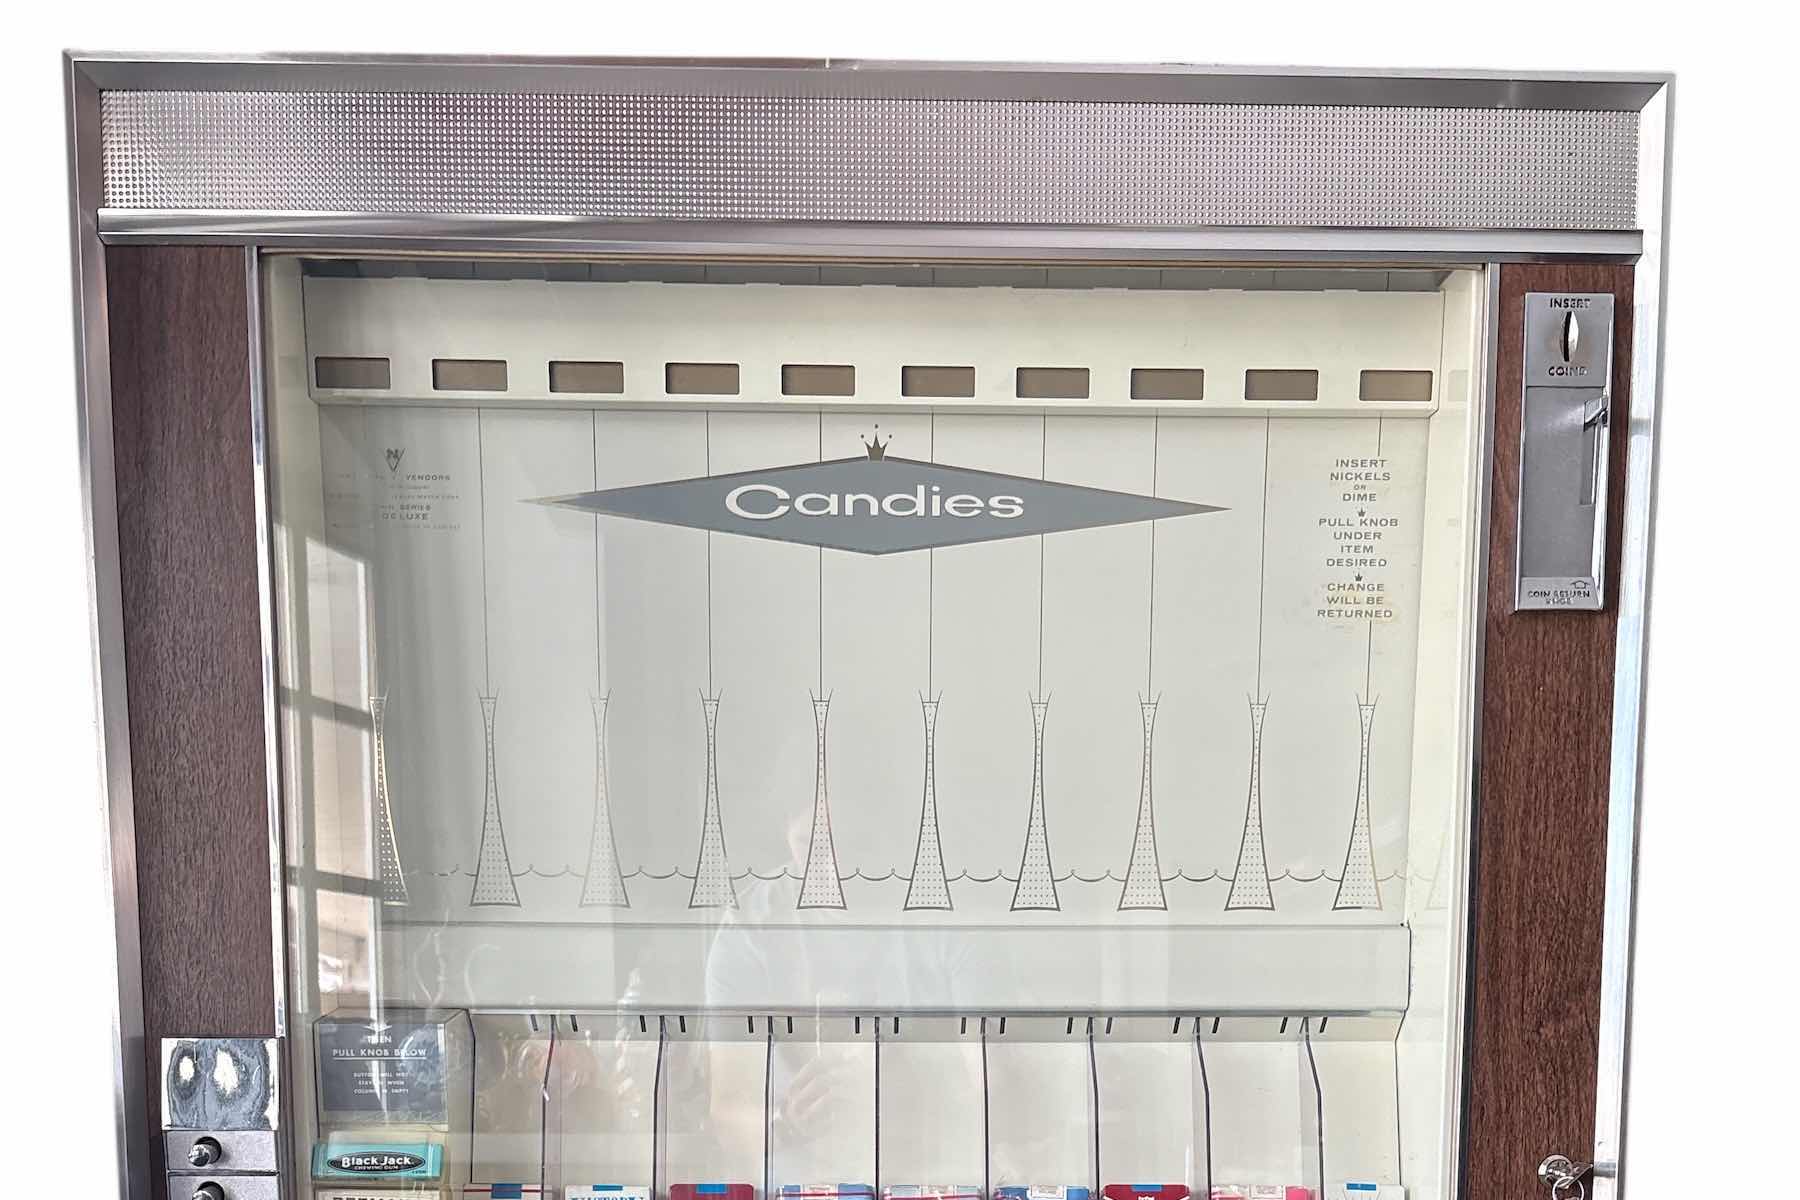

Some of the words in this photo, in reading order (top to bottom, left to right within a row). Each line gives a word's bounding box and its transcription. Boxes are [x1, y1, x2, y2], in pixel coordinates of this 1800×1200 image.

[1335, 458, 1388, 468] INSERT
[1330, 472, 1391, 481] NICKELS
[725, 484, 1025, 520] Candies
[1342, 493, 1377, 502] DIME
[1319, 518, 1354, 527] PULL
[1359, 518, 1399, 527] KNOB
[1333, 531, 1382, 540] UNDER
[1340, 545, 1374, 553] ITEM
[1326, 558, 1387, 567] DESIRED
[1327, 583, 1385, 592] CHANGE
[1326, 596, 1361, 605] WILL
[1366, 596, 1384, 605] BE
[1317, 609, 1393, 618] RETURNED
[332, 1049, 355, 1057] PULL
[360, 1049, 389, 1057] KNOB
[341, 1156, 382, 1168] Black
[380, 1156, 412, 1166] Jack
